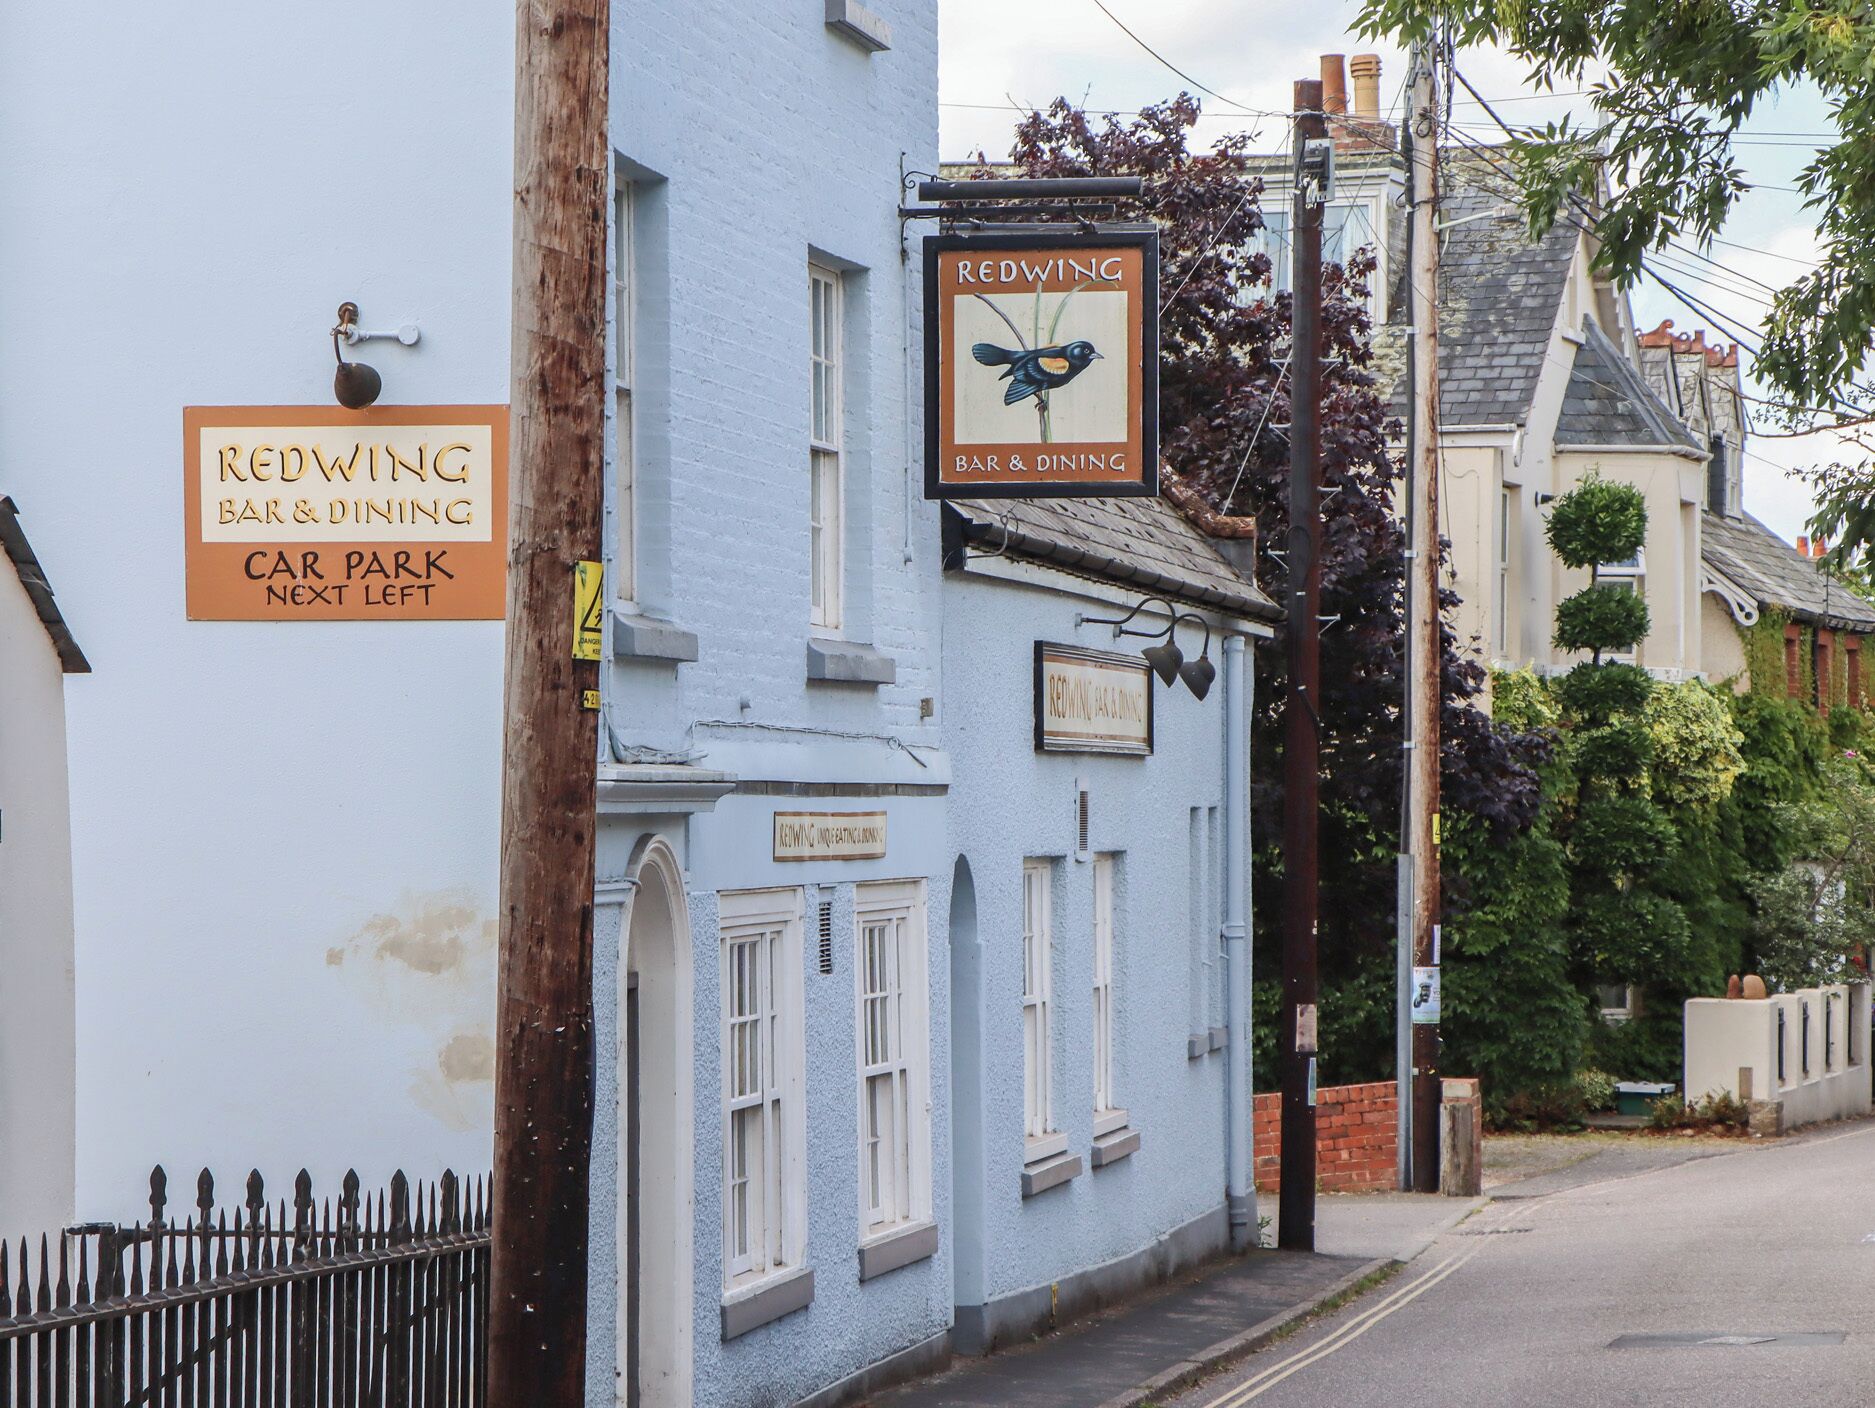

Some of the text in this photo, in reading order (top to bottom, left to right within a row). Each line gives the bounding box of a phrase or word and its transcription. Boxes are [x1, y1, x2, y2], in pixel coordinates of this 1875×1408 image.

[957, 257, 1122, 284] REDWING
[218, 442, 473, 483] REDWING
[955, 453, 1126, 472] BAR & DINING
[218, 498, 473, 525] BAR & DINING
[244, 550, 455, 581] CAR PARK
[266, 583, 437, 606] NEXT LEFT
[1049, 672, 1092, 722] REDWING
[779, 823, 815, 849] REDWING
